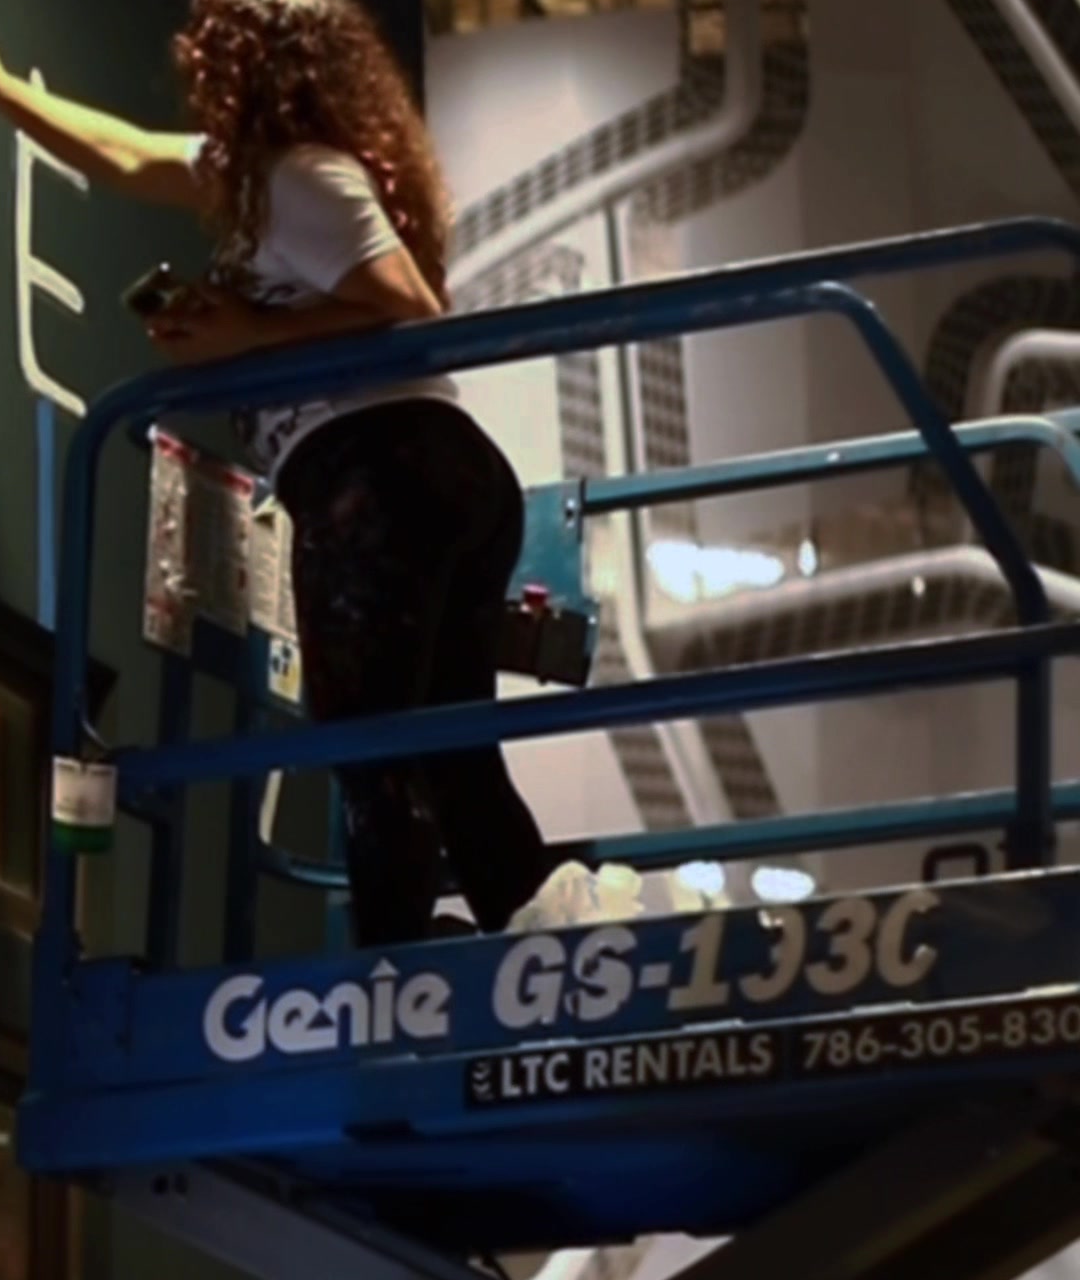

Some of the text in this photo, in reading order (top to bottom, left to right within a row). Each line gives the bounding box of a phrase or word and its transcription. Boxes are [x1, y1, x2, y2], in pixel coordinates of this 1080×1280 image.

[202, 956, 452, 1062] Genie
[500, 1050, 572, 1099] LTC
[583, 1032, 776, 1091] RENTALS
